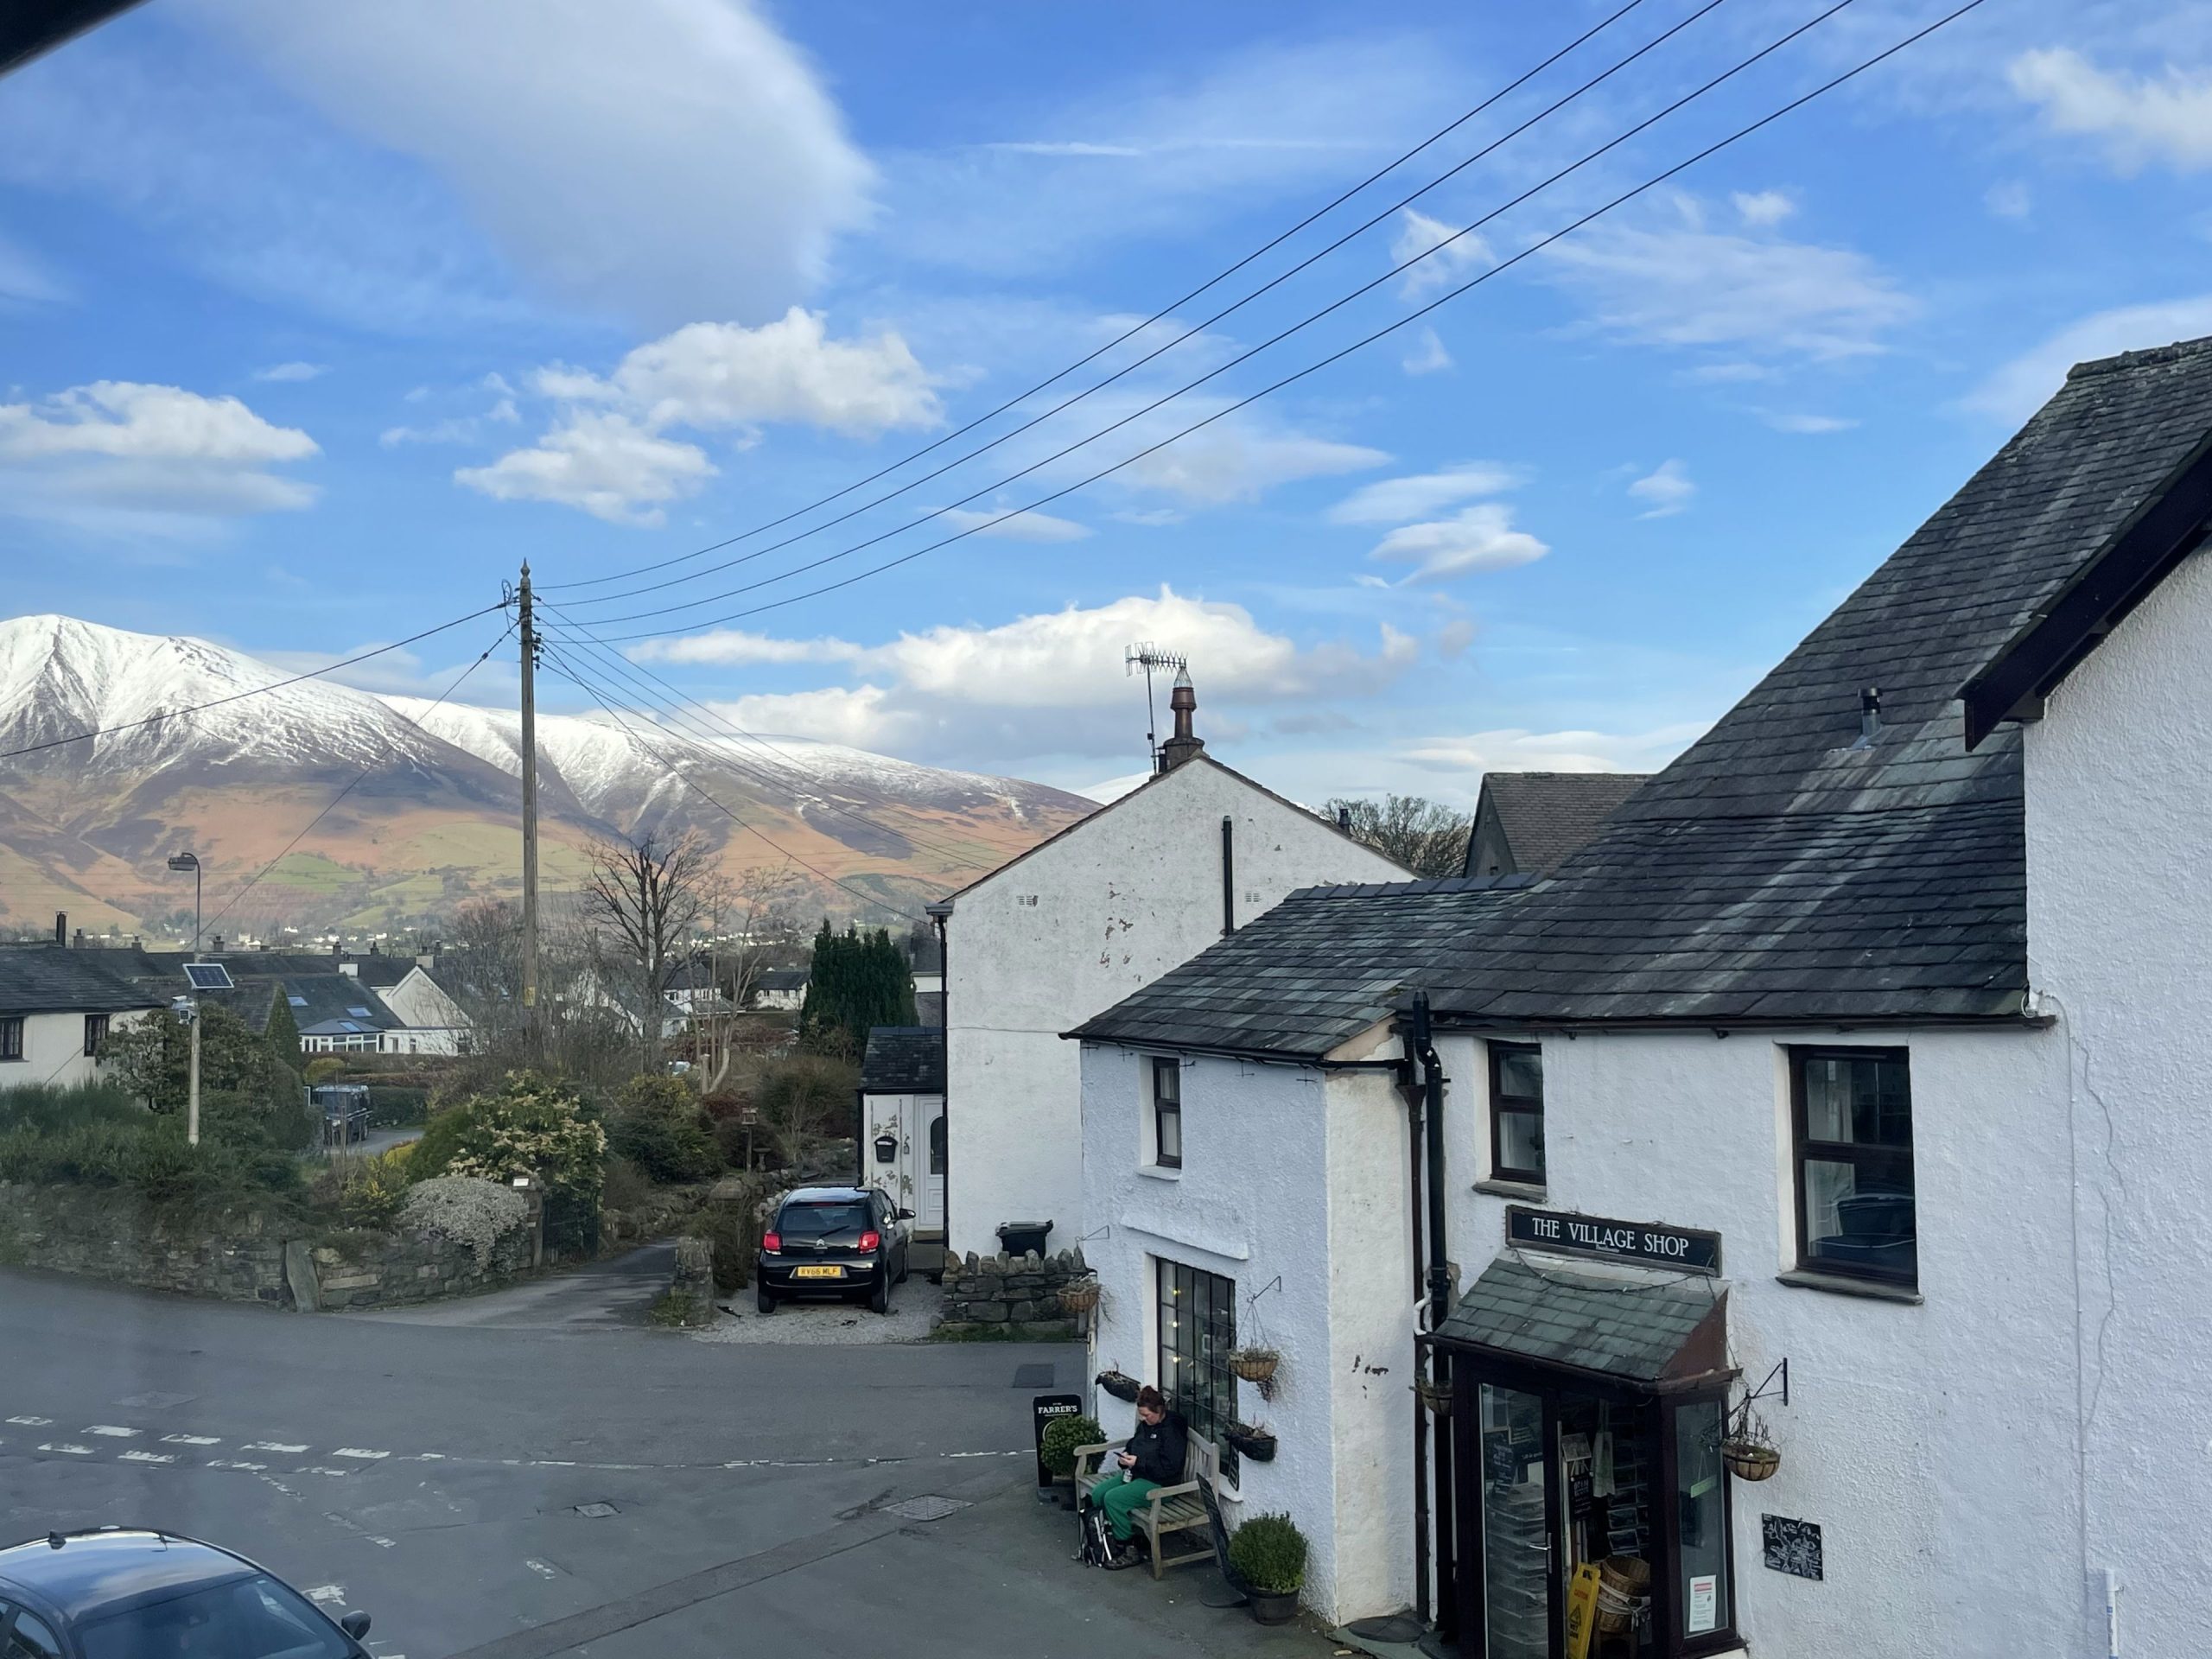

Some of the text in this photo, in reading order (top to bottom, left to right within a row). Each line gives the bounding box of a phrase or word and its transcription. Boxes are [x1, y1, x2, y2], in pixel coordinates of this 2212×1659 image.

[1532, 1217, 1689, 1256] THE VILLAGE SHOP
[1038, 1405, 1077, 1414] FARRER'S
